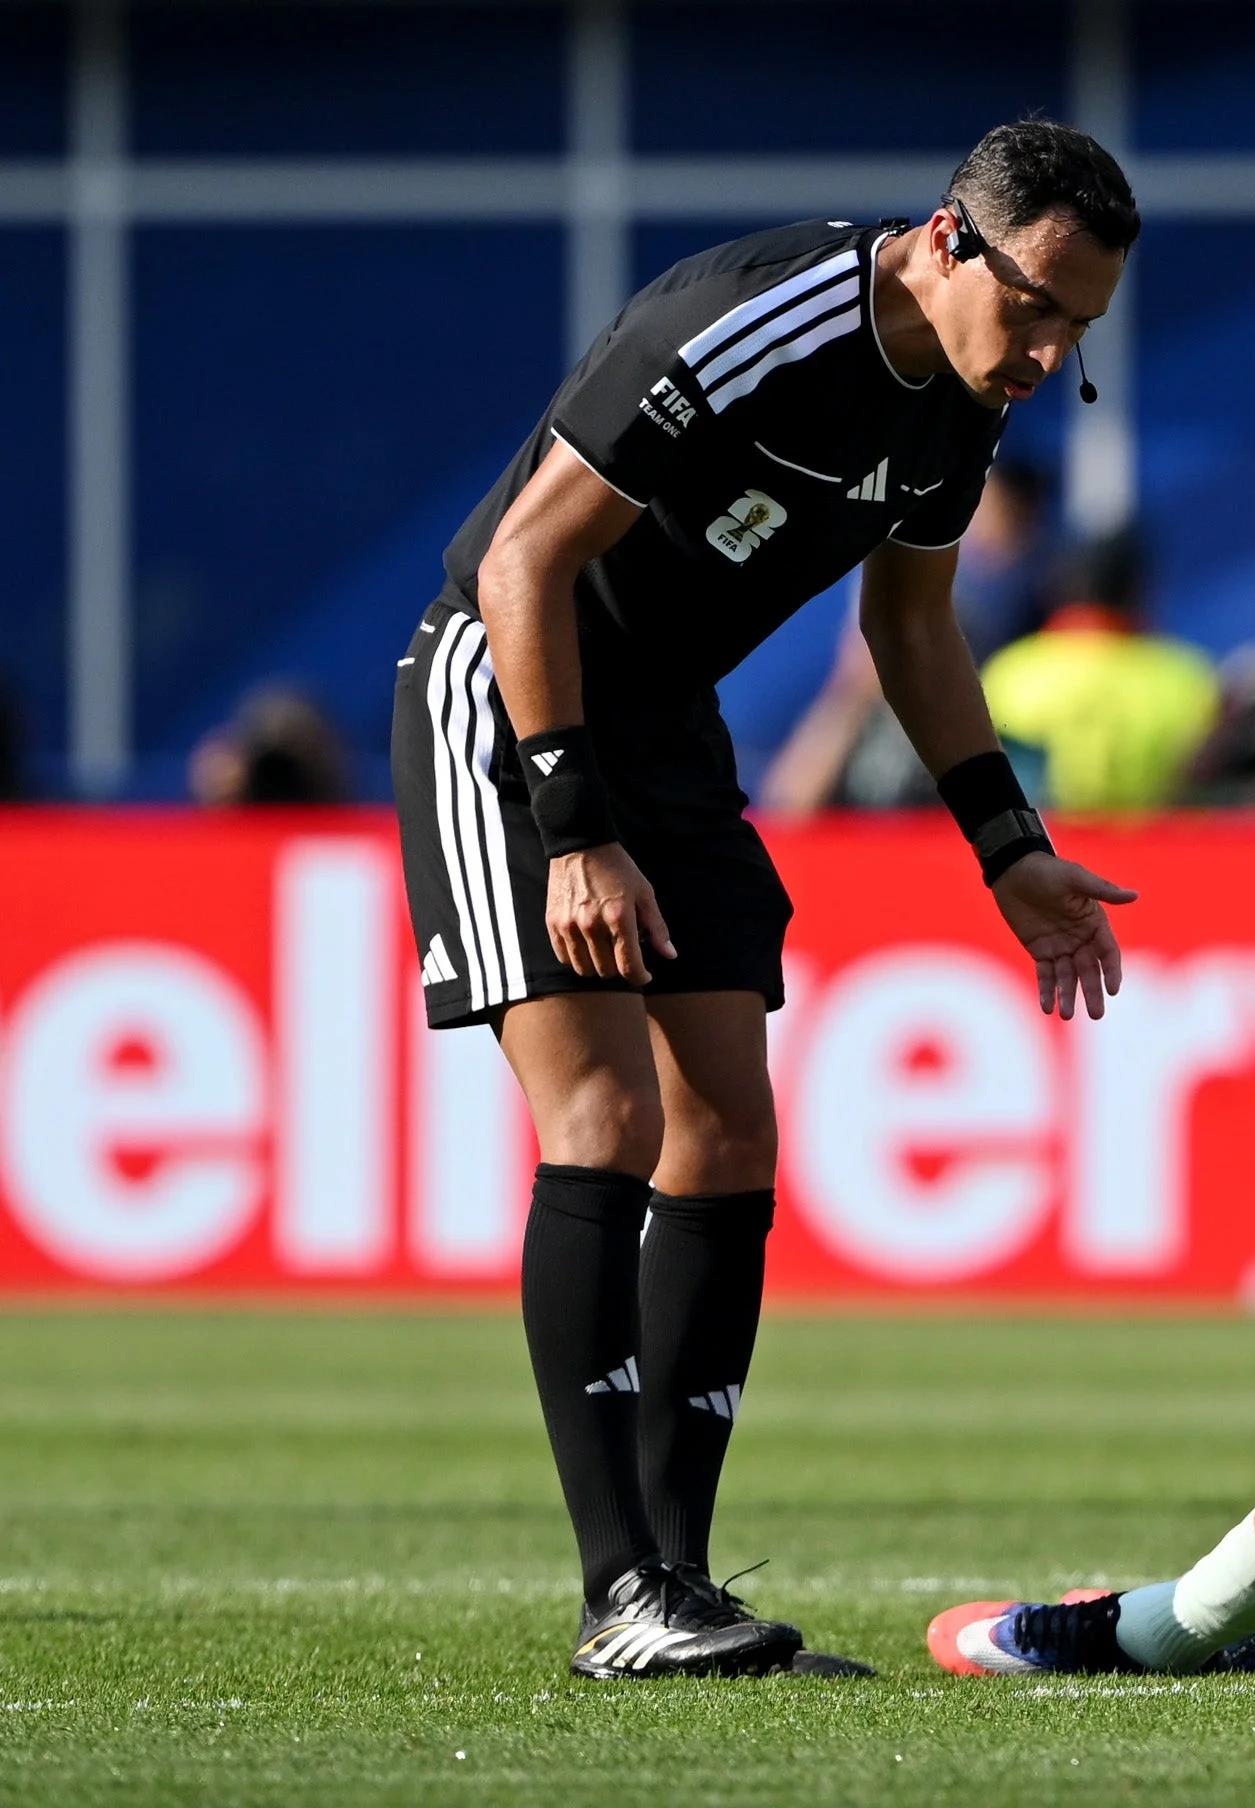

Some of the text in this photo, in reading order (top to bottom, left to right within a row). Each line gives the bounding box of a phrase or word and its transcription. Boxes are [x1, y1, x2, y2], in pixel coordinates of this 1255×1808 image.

[639, 397, 681, 438] TEAM ONE
[650, 376, 697, 428] FIFA
[717, 533, 738, 553] FIFA
